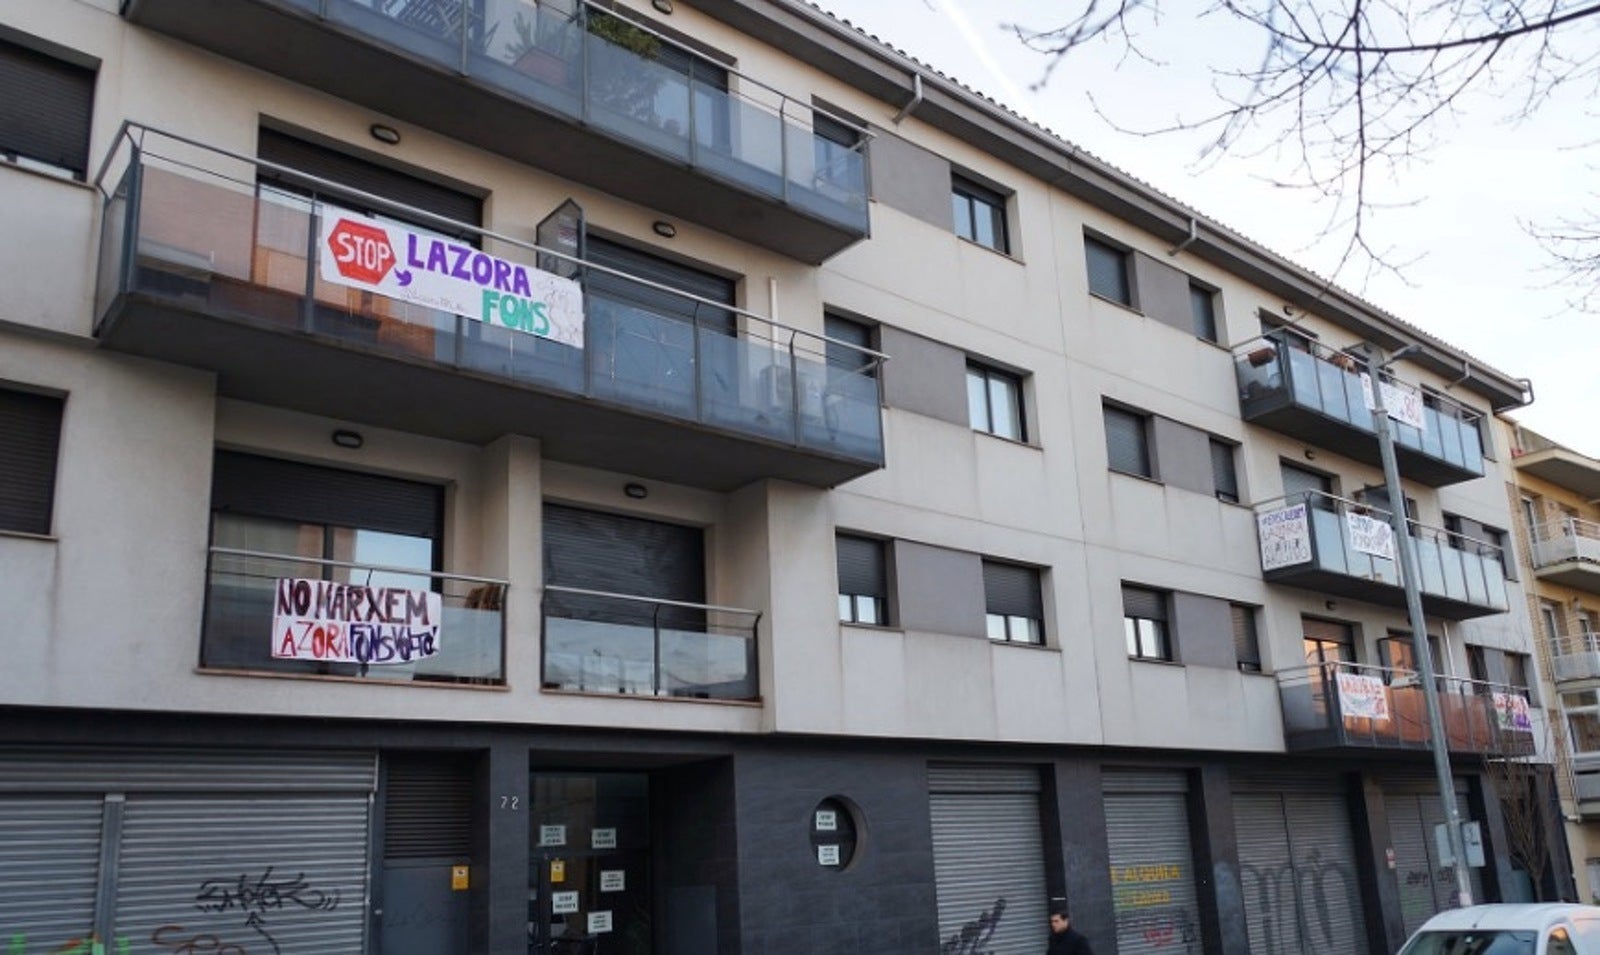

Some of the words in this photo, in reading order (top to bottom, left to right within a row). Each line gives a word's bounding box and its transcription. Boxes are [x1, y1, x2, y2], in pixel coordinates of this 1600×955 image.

[336, 232, 390, 272] STOP
[407, 233, 532, 297] LAZORA
[482, 289, 550, 336] FONS
[277, 578, 311, 617] NO
[314, 582, 430, 626] MARXEM
[350, 624, 394, 662] FONS
[501, 796, 519, 810] 72
